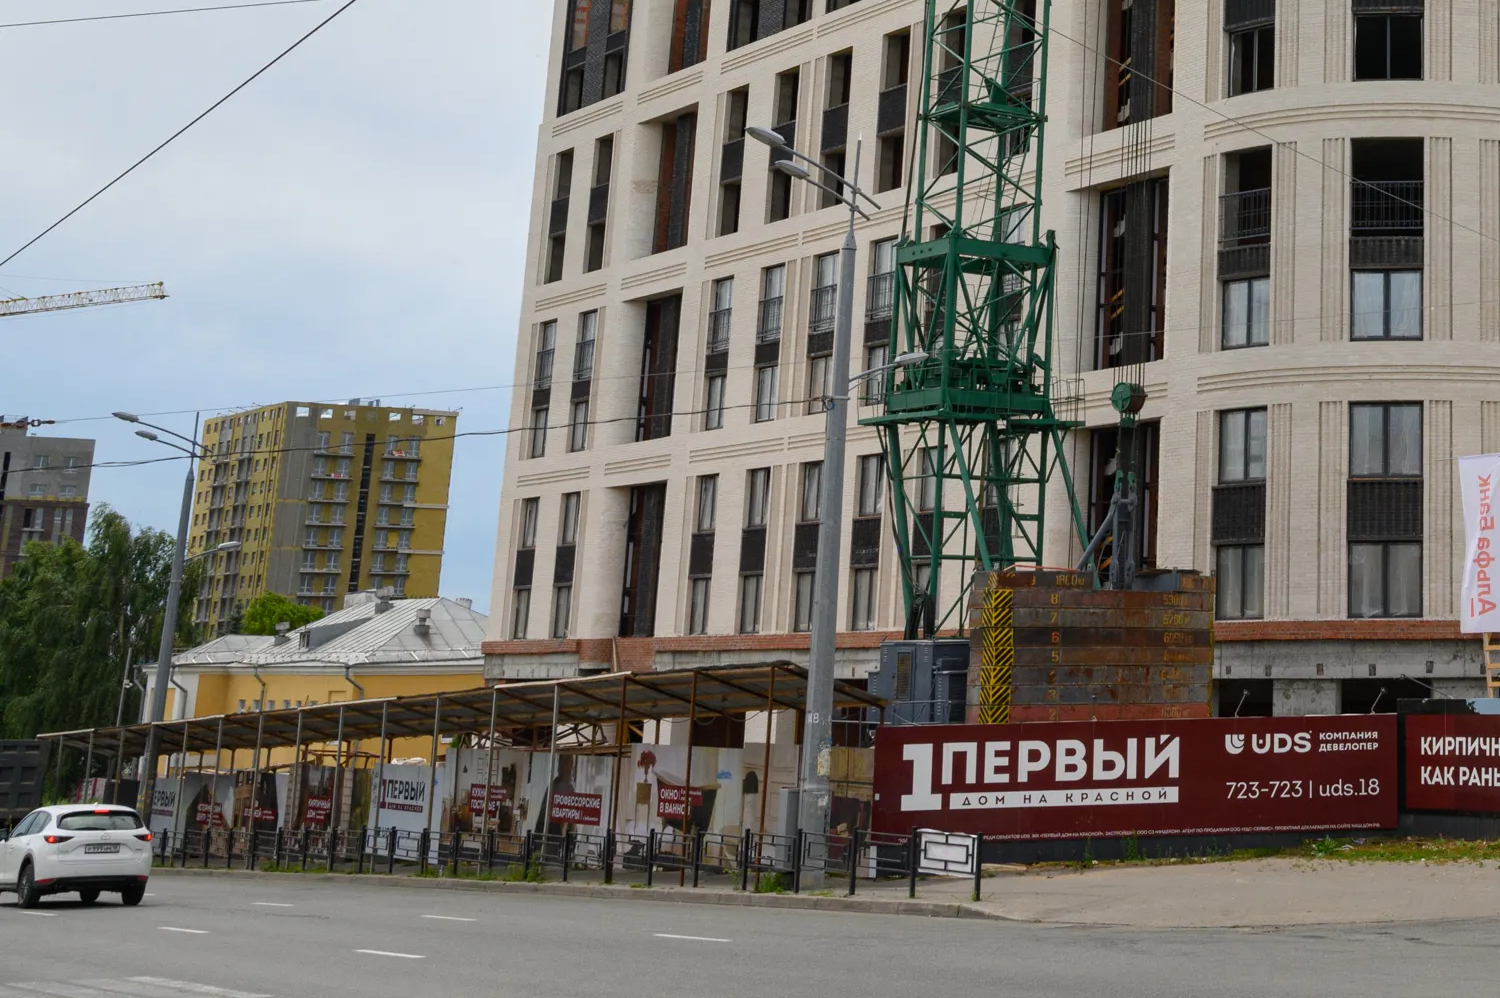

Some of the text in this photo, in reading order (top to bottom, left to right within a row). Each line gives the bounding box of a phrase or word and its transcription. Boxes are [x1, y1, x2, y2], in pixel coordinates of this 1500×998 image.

[1051, 632, 1060, 643] 6
[1051, 650, 1059, 662] 5
[1319, 731, 1379, 741] КОМПАНИЯ
[1252, 732, 1312, 754] UDS
[1318, 742, 1379, 753] ДЕВЕЛОПЕР
[901, 743, 942, 811] 1
[942, 734, 1180, 785] ПЕРВЫЙ
[1420, 766, 1455, 785] КАК
[387, 779, 425, 802] ПЕРВЫЙ
[660, 788, 678, 800] ОКНО
[1226, 778, 1380, 799] 723-723 uds.18
[554, 794, 600, 808] ПРОФЕССОРСКИЕ
[962, 788, 1167, 806] ДОМ НА КРАСНОЙ
[552, 807, 580, 820] КВАРТИРЫ
[659, 802, 664, 813] В
